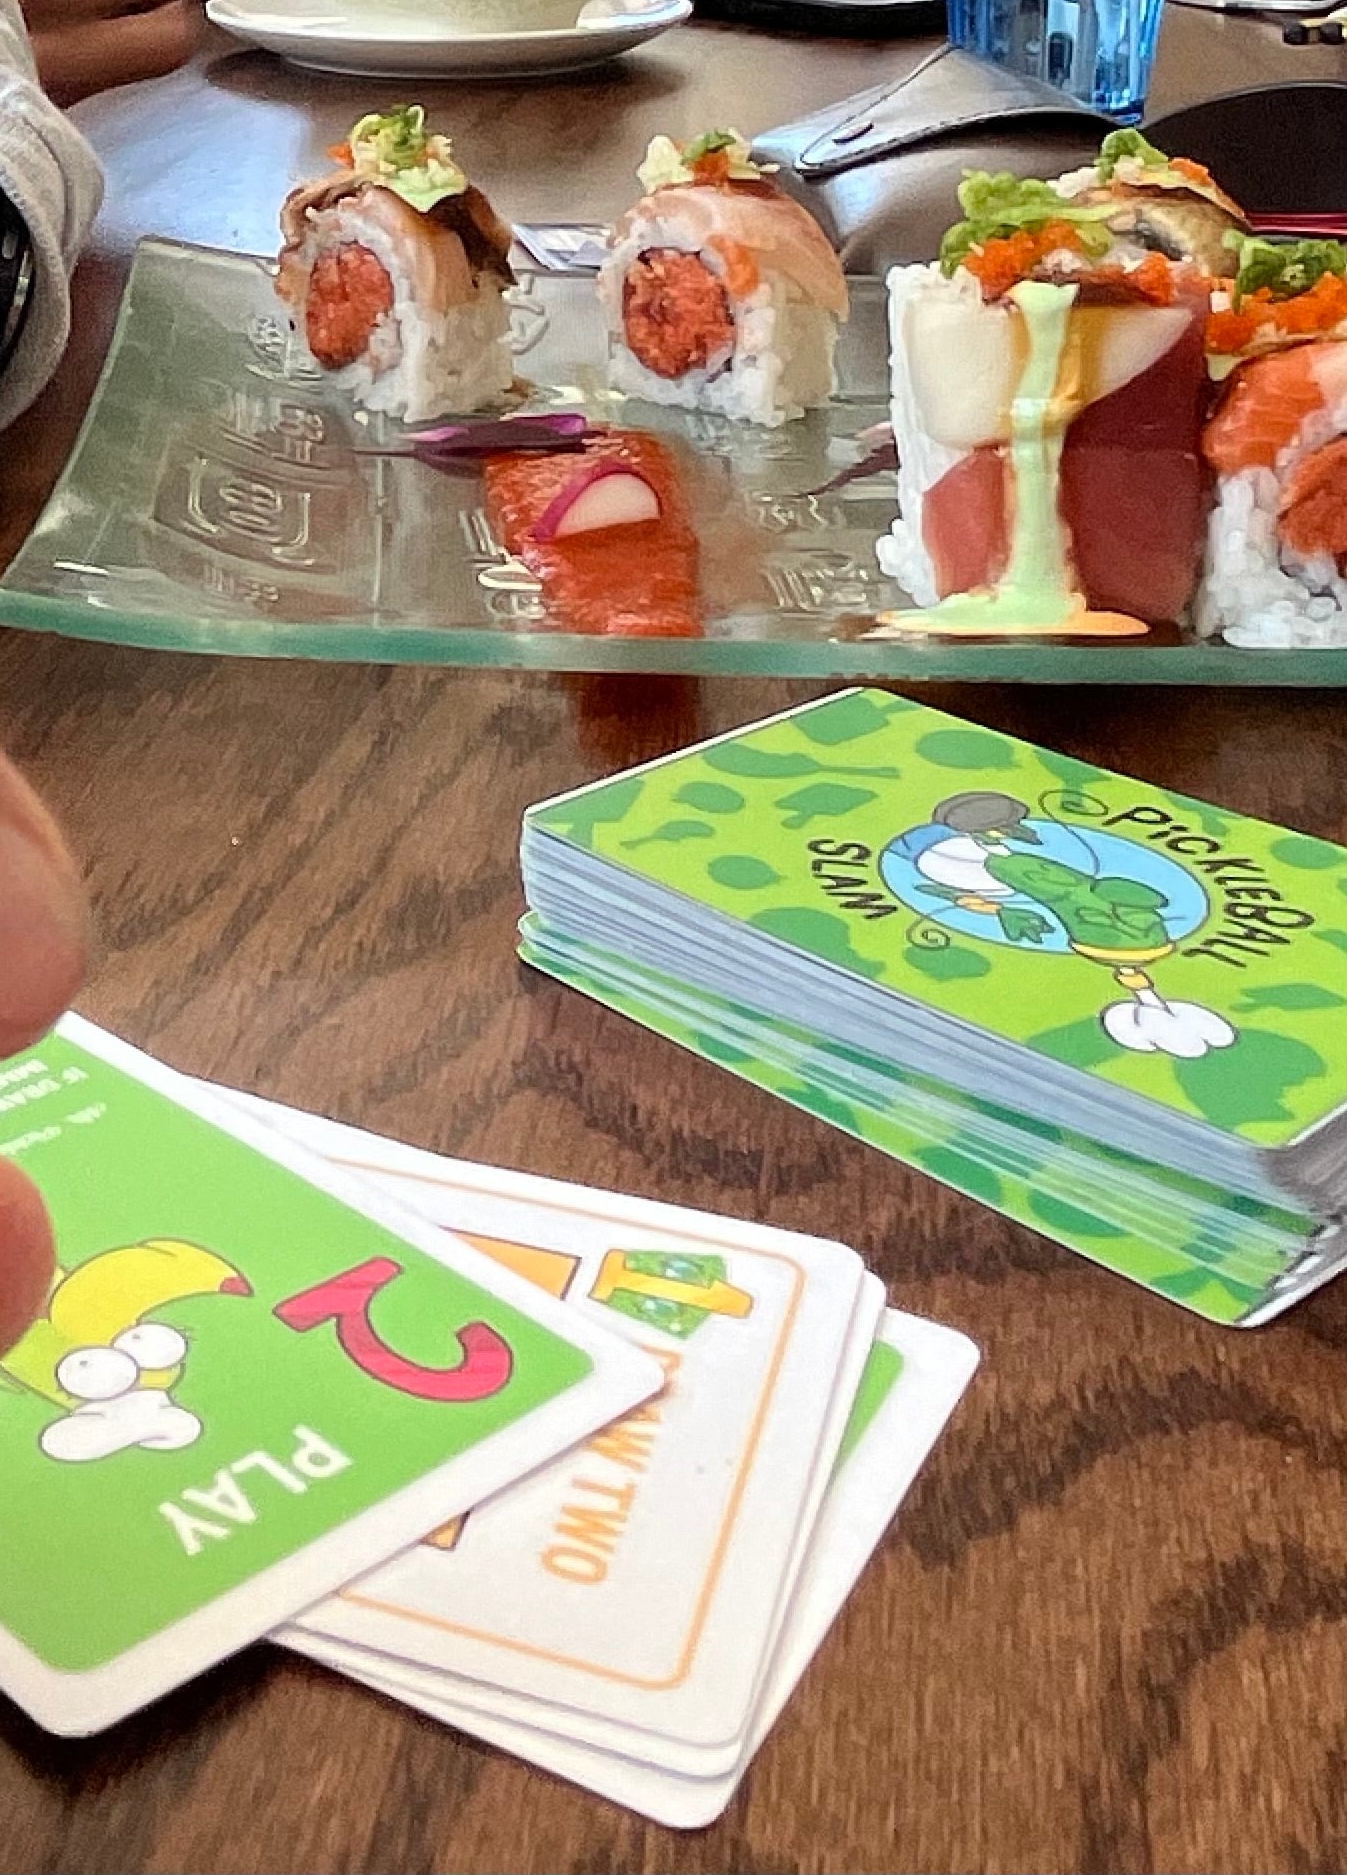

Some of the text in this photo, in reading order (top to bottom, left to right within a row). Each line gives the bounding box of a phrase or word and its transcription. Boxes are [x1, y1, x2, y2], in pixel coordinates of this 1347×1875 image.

[807, 836, 899, 922] SLAM
[272, 1254, 515, 1403] 2
[158, 1424, 352, 1556] PLAY
[541, 1479, 637, 1586] TWO
